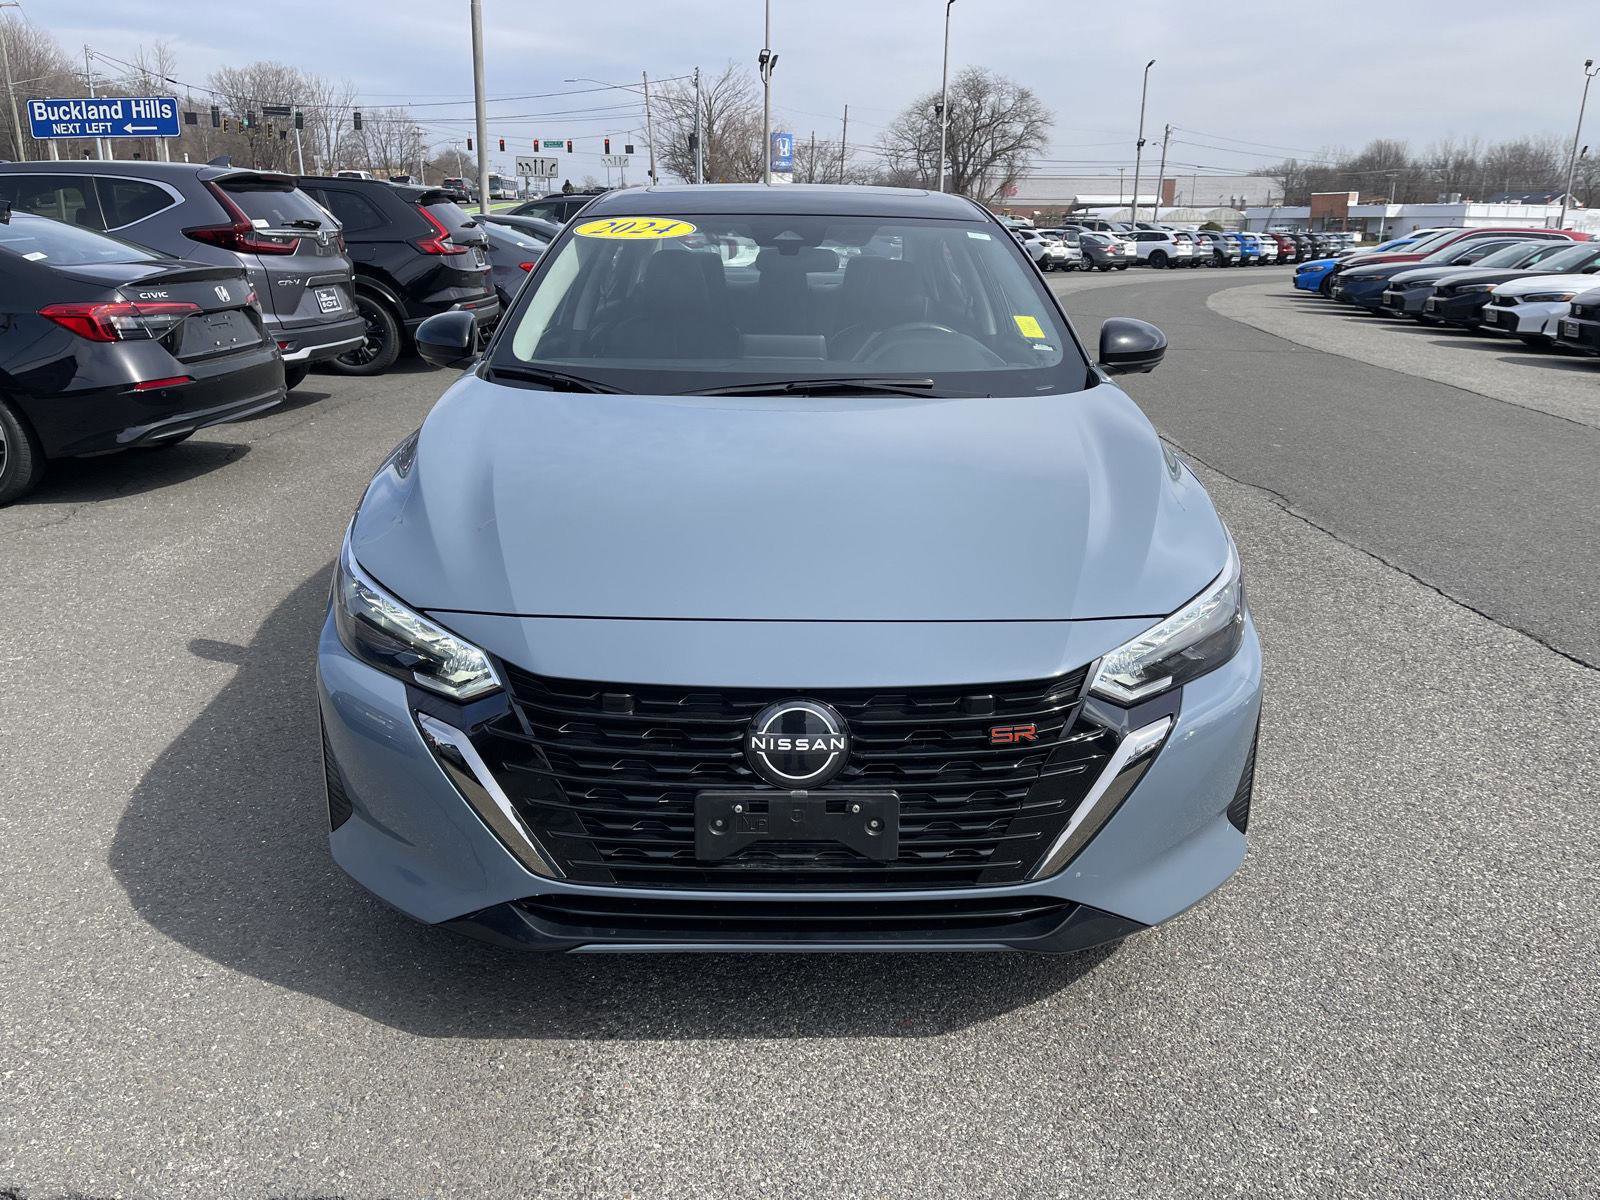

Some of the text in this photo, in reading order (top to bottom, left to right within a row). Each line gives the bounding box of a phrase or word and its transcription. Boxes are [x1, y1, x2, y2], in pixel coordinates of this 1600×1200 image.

[33, 100, 173, 121] Buckland Hills
[52, 122, 112, 134] NEXT LEFT
[588, 221, 681, 235] 2024
[139, 291, 169, 299] CIVIC
[991, 724, 1039, 744] SR
[751, 736, 845, 751] NISSAN
